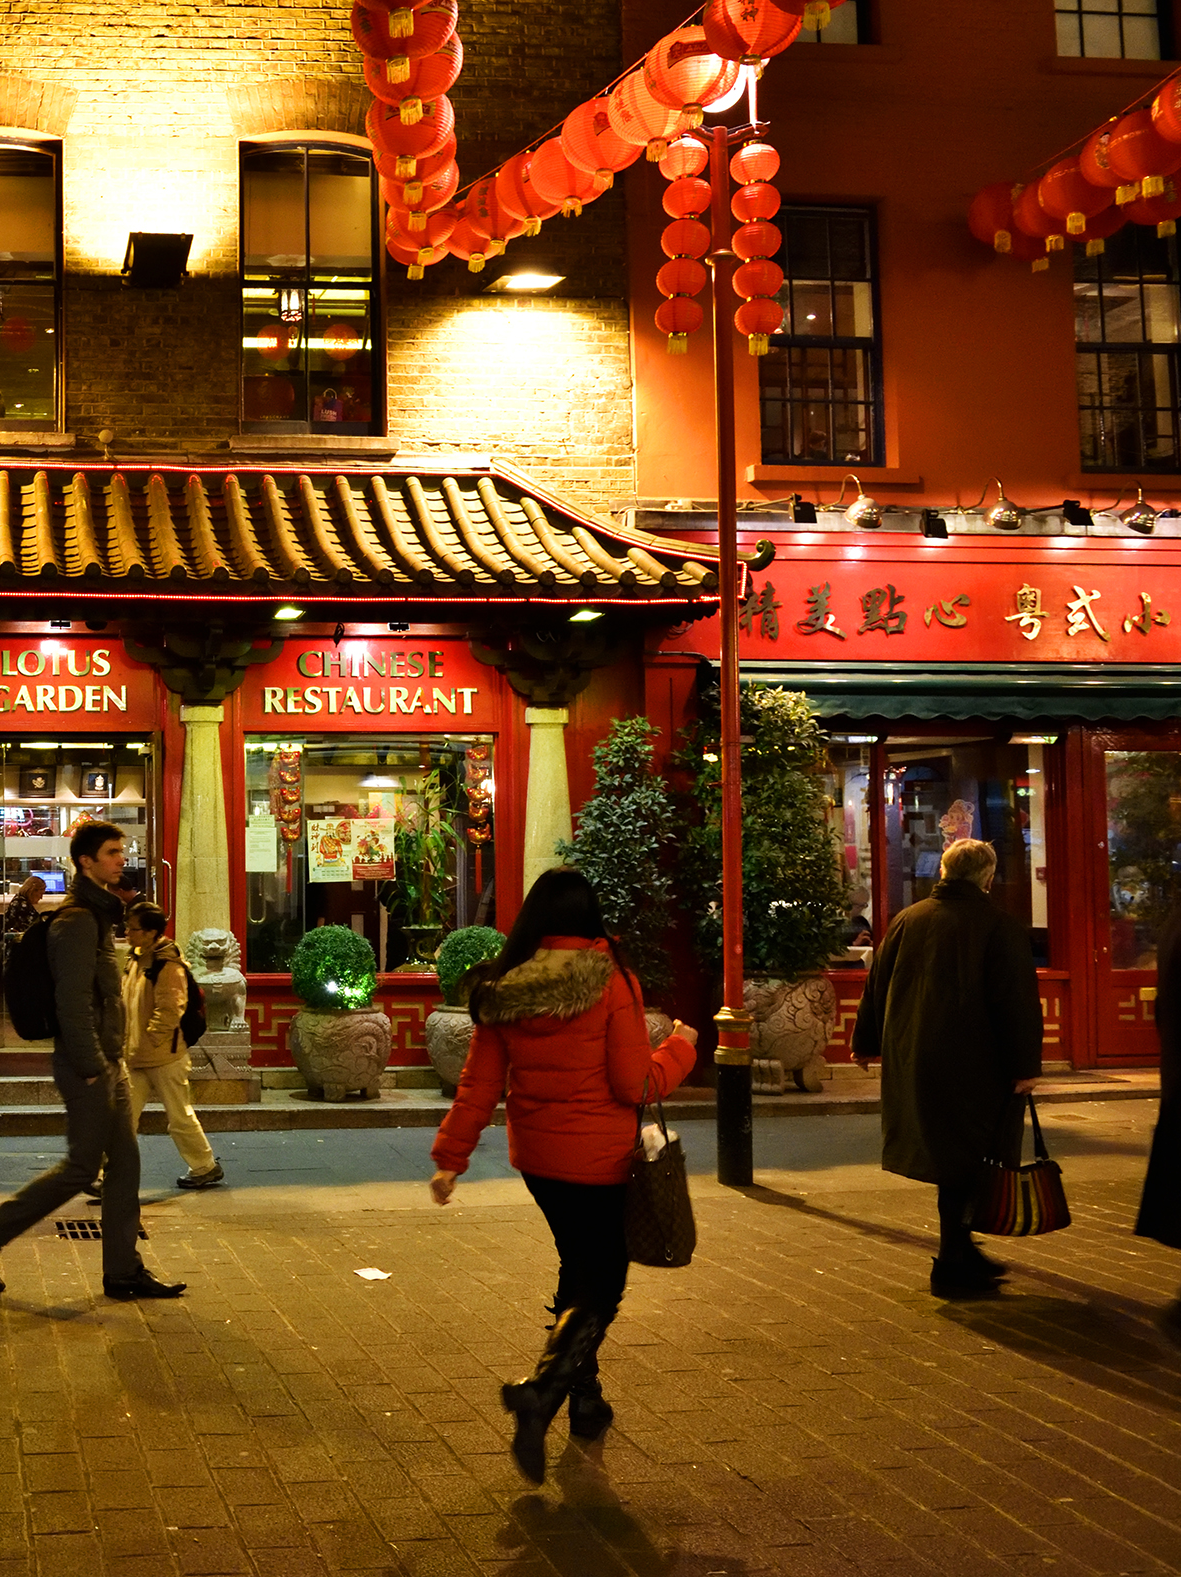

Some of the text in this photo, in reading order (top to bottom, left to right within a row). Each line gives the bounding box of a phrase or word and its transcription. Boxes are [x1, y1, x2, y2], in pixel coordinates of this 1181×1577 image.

[1, 648, 111, 677] LOTUS
[298, 651, 444, 679] CHINESE
[264, 686, 479, 715] RESTAURANT
